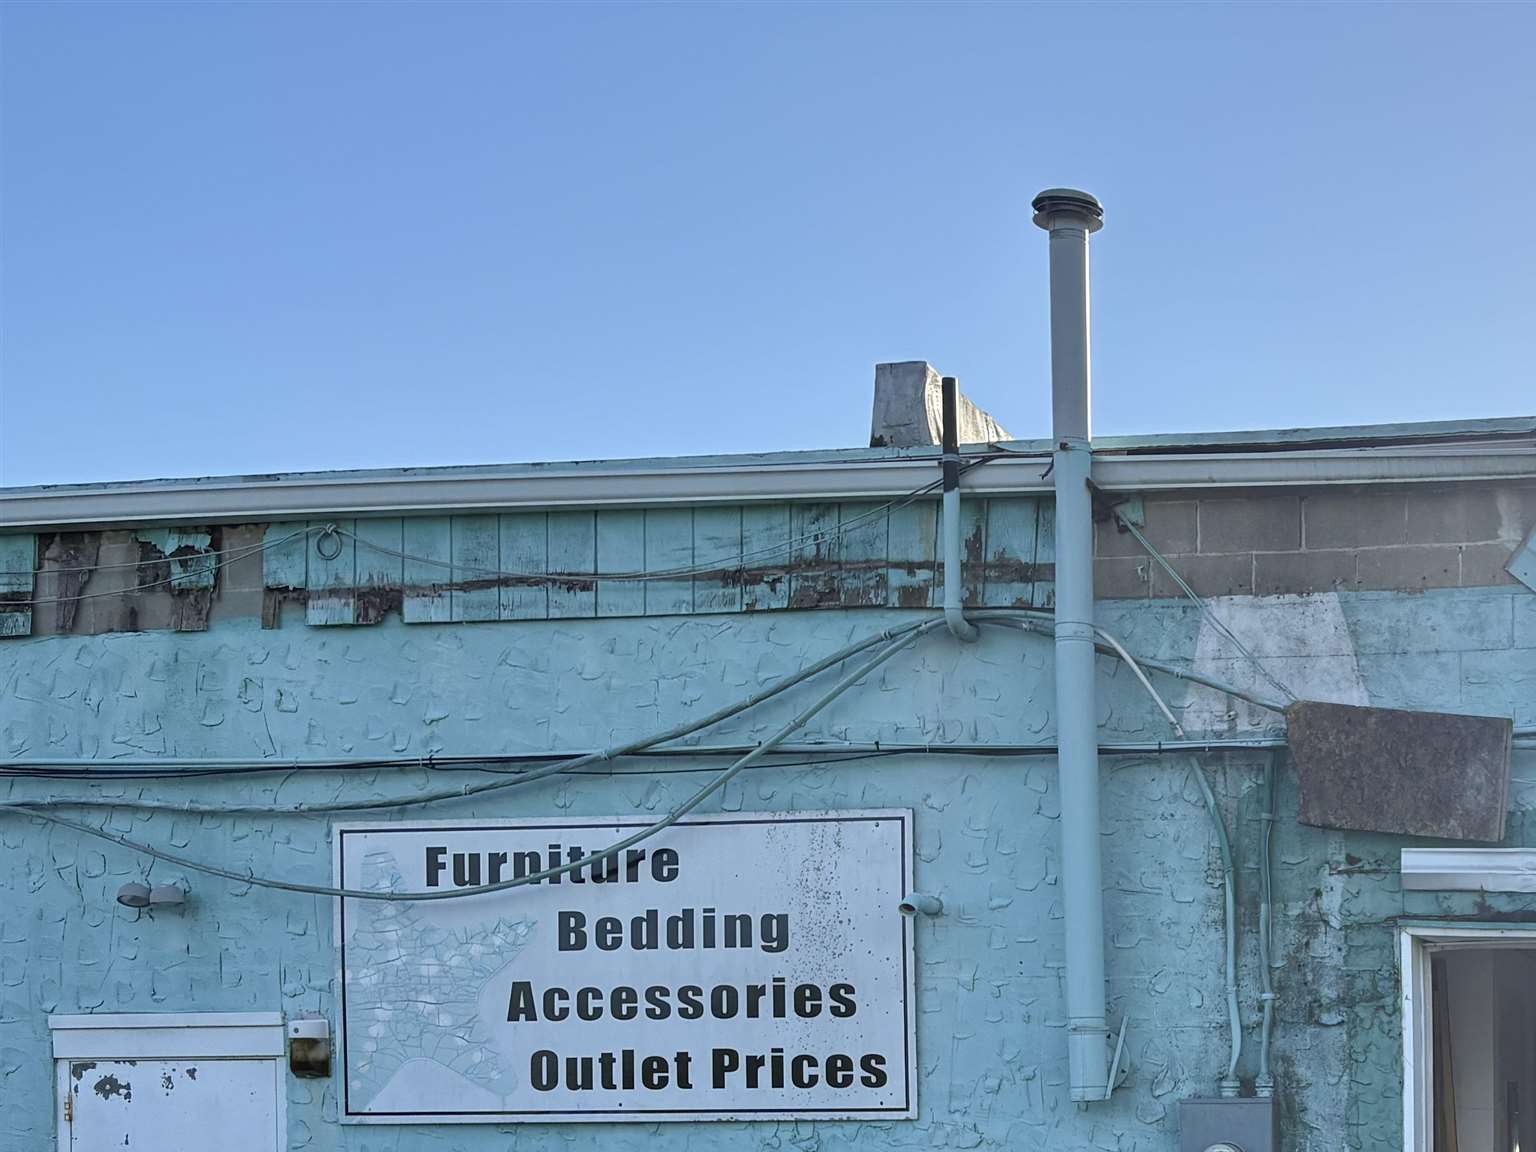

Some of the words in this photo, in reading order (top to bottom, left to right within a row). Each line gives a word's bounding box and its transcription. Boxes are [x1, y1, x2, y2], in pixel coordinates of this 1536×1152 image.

[425, 843, 680, 887] Furniture
[557, 908, 790, 953] Bedding
[506, 976, 857, 1023] Accessories
[530, 1048, 692, 1092] Outlet
[711, 1047, 888, 1090] Prices
